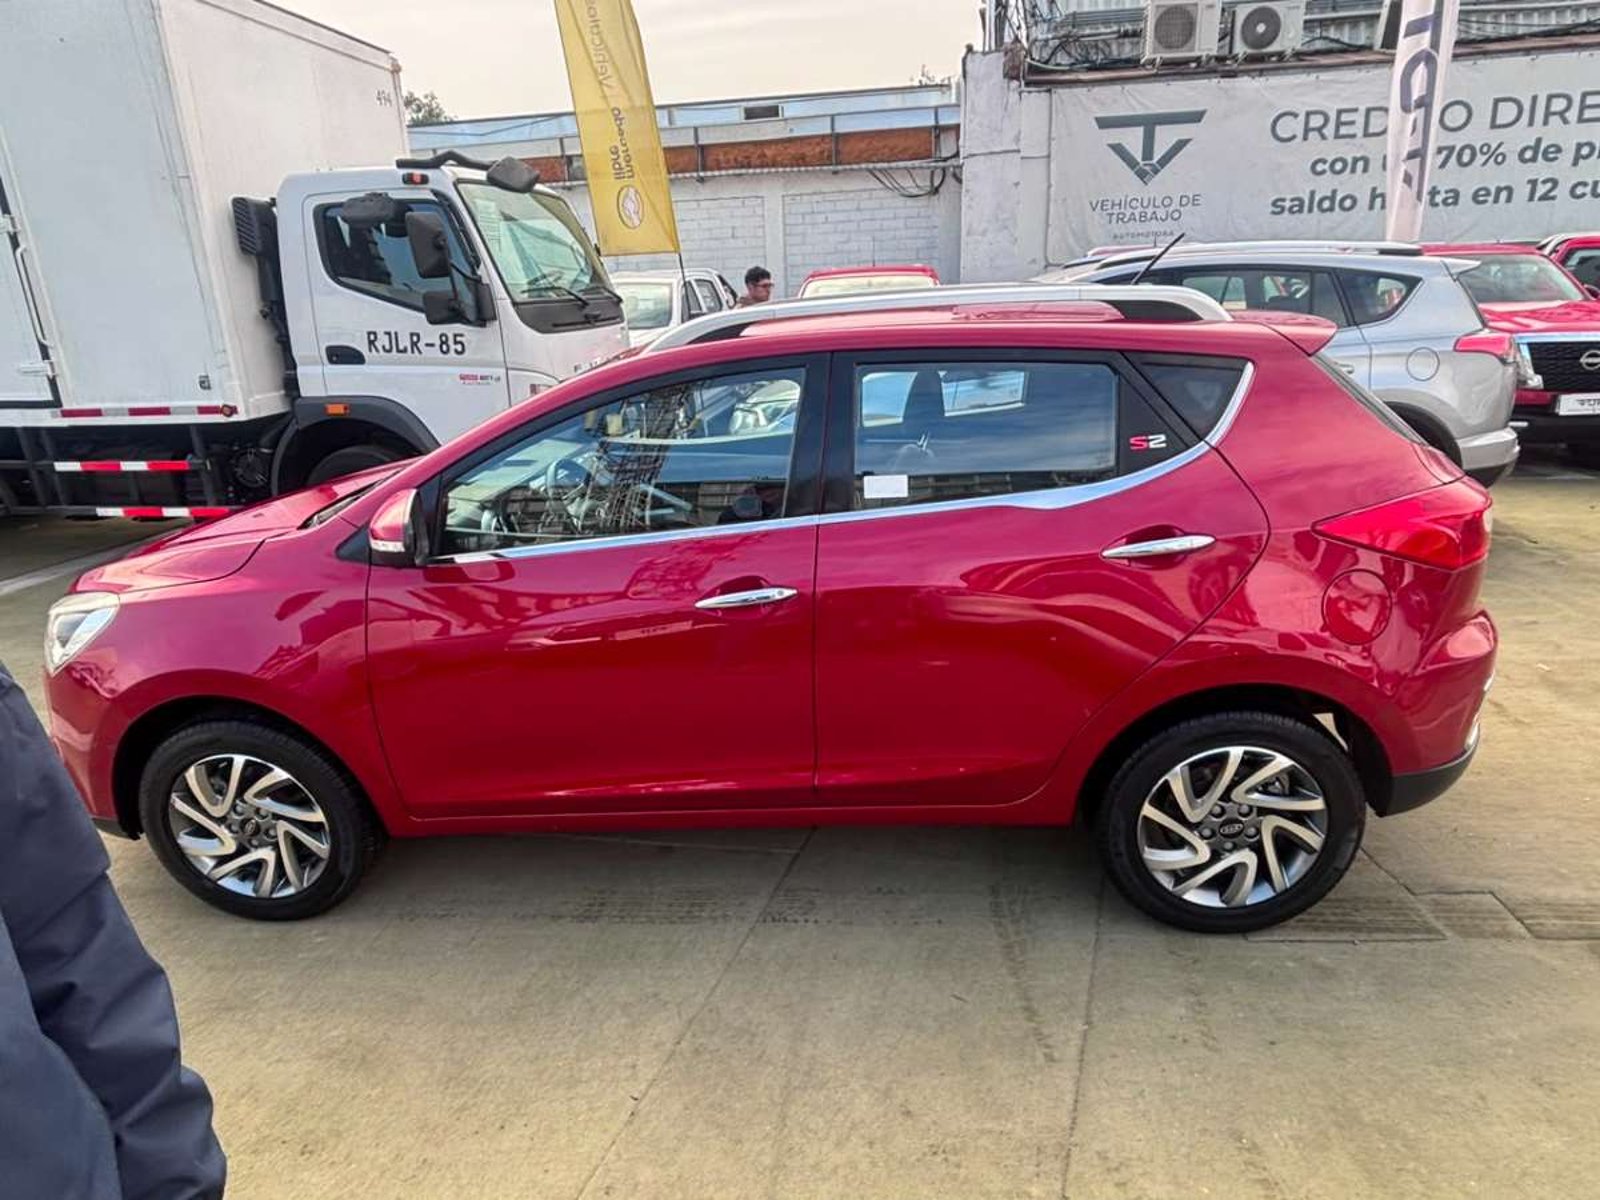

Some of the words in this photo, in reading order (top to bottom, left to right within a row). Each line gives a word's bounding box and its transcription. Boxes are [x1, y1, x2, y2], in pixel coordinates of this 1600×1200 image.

[1270, 99, 1474, 143] CREDO
[1489, 90, 1600, 130] DIRE
[1310, 154, 1370, 176] con
[1436, 141, 1507, 170] 70%
[1517, 136, 1563, 164] de
[1179, 194, 1202, 208] DE
[1270, 188, 1358, 216] saldo
[1367, 186, 1461, 211] hta
[1471, 184, 1514, 205] en
[1526, 177, 1559, 202] 12
[1106, 208, 1183, 224] TRABAJO
[366, 330, 466, 355] RJLR-85
[1129, 433, 1167, 449] S2
